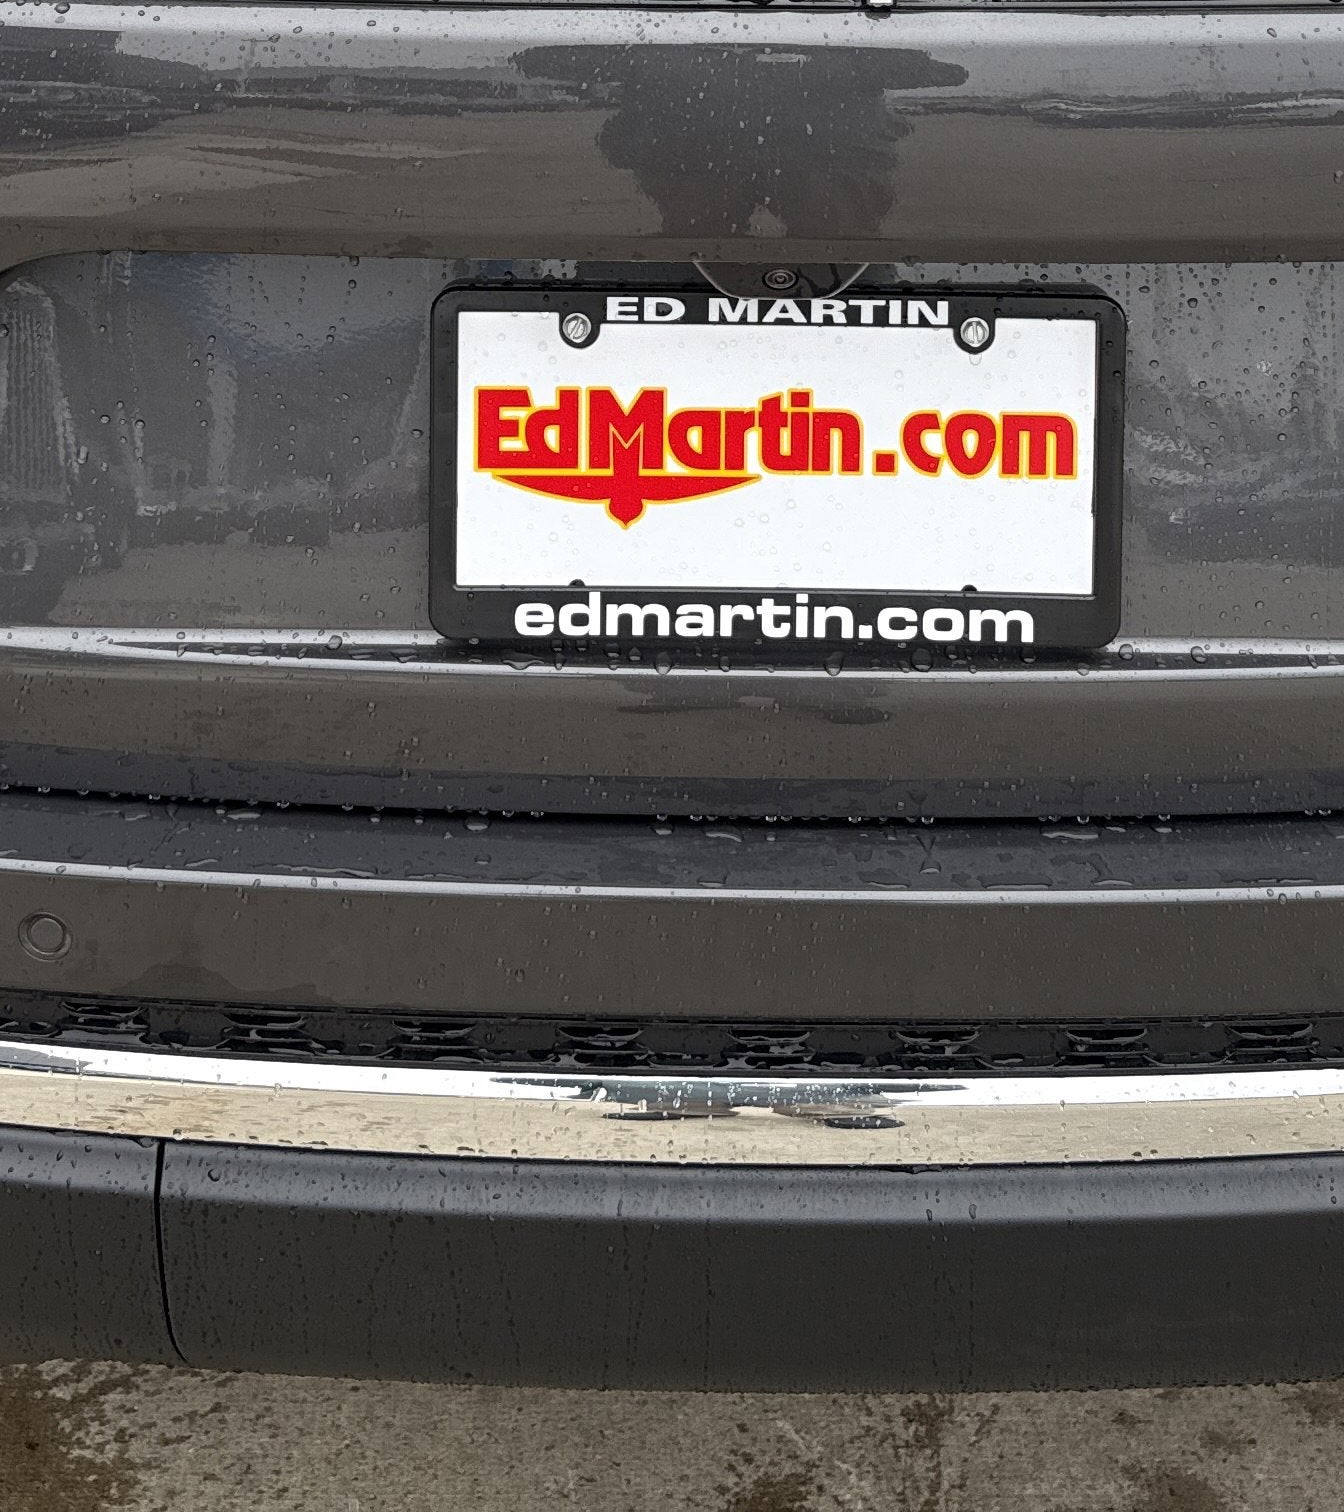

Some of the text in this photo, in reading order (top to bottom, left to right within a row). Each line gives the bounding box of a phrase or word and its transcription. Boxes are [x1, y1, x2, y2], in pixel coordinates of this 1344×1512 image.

[606, 296, 950, 326] ED MARTIN
[474, 385, 1078, 482] EdMartin.com
[514, 591, 1035, 644] edmartin.com
